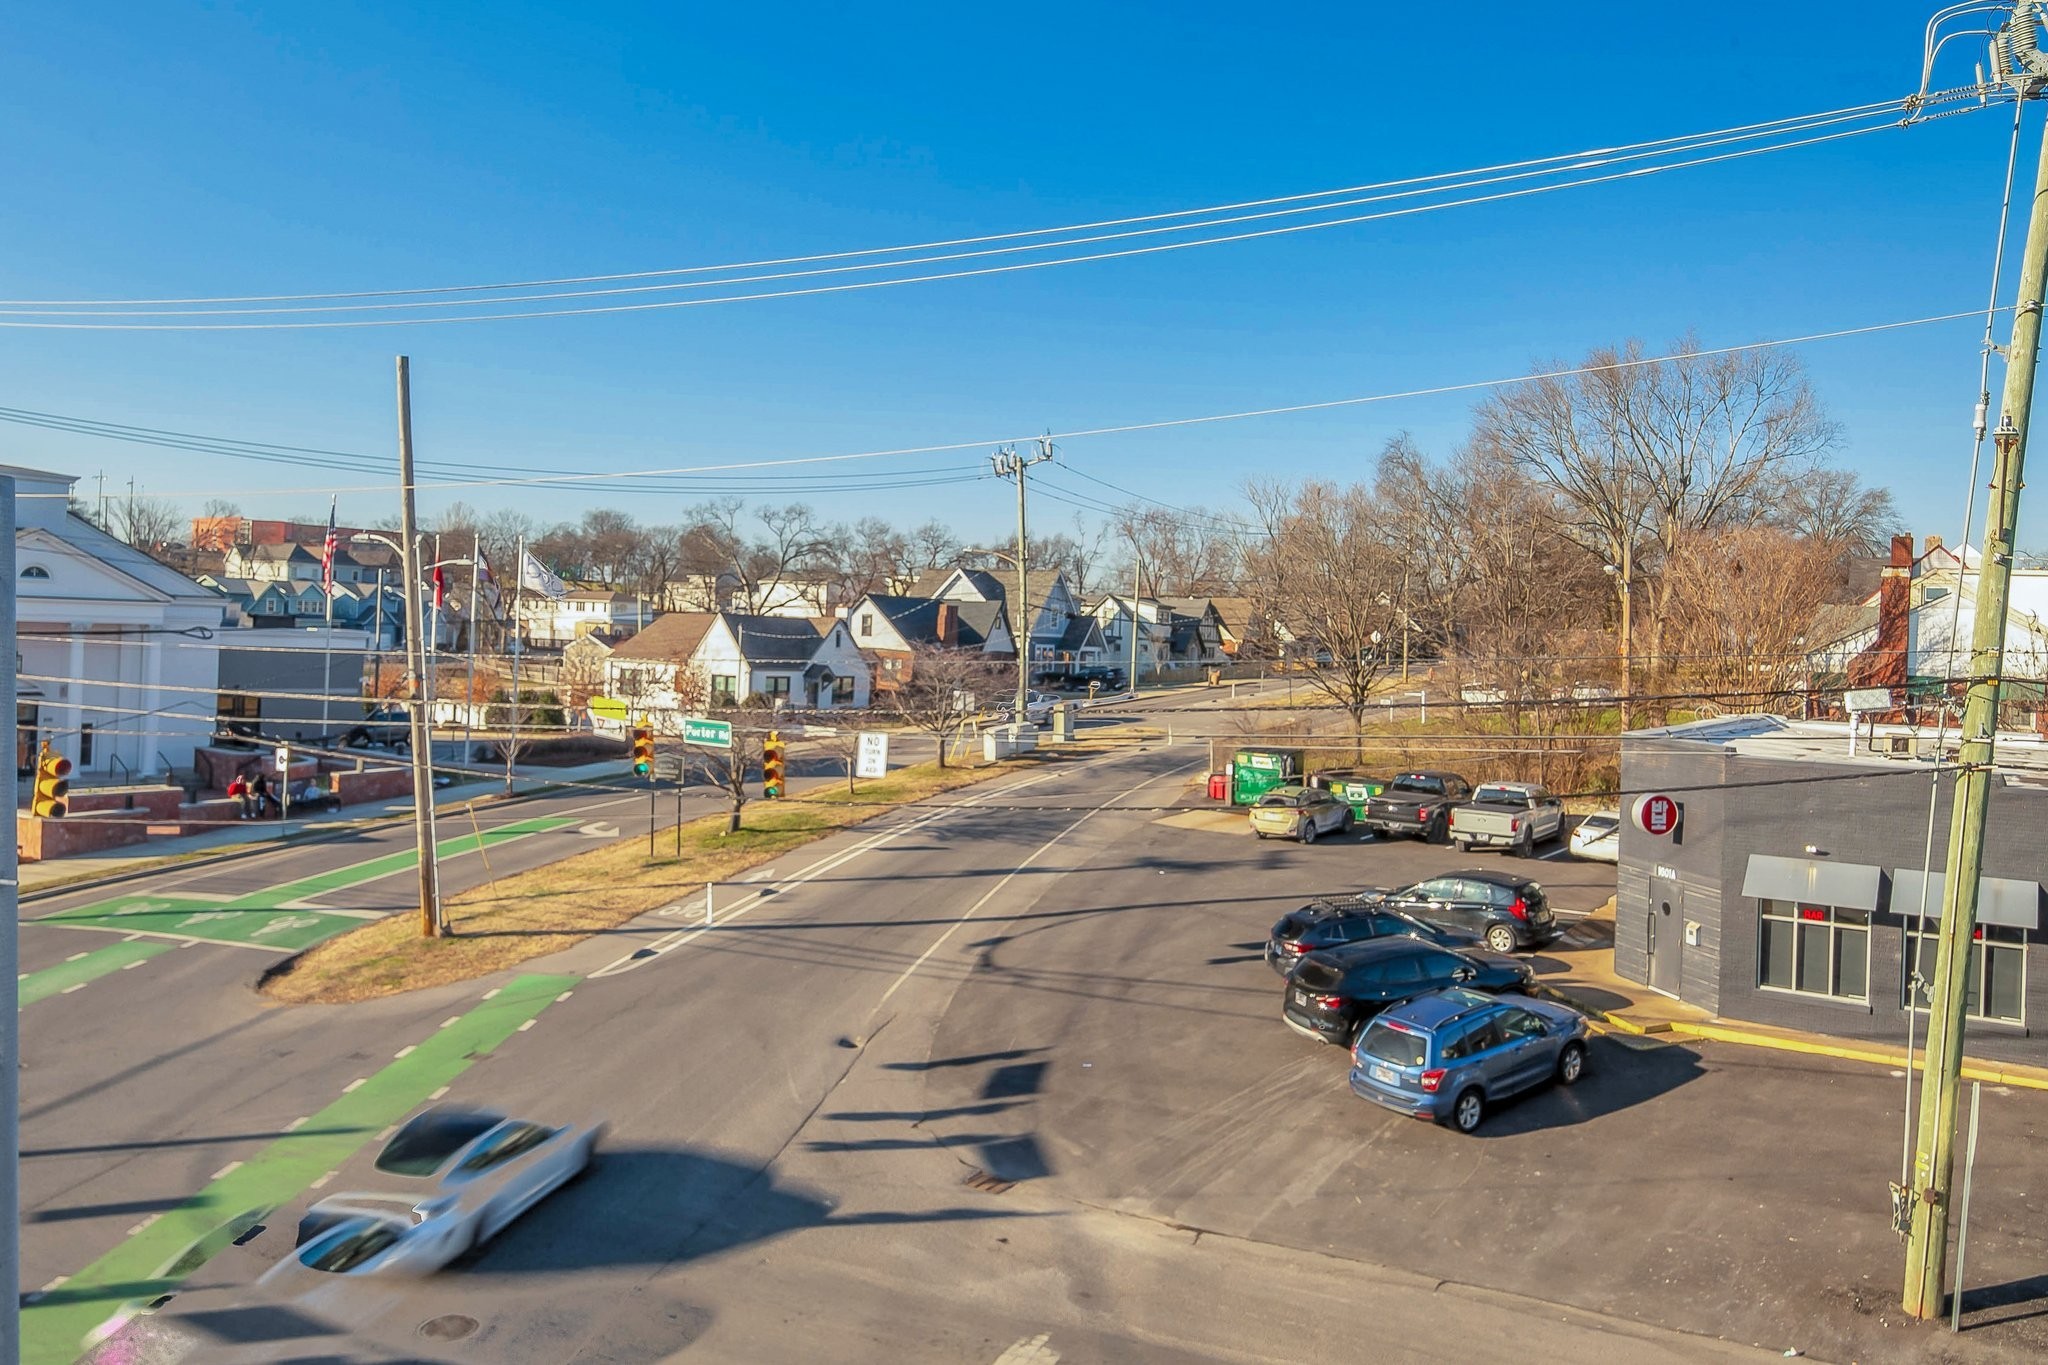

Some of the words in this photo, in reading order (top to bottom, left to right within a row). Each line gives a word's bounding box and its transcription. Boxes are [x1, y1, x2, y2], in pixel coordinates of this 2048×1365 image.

[686, 725, 715, 738] Porter
[718, 730, 729, 740] Rd
[867, 736, 880, 746] NO
[1804, 909, 1824, 921] BAR
